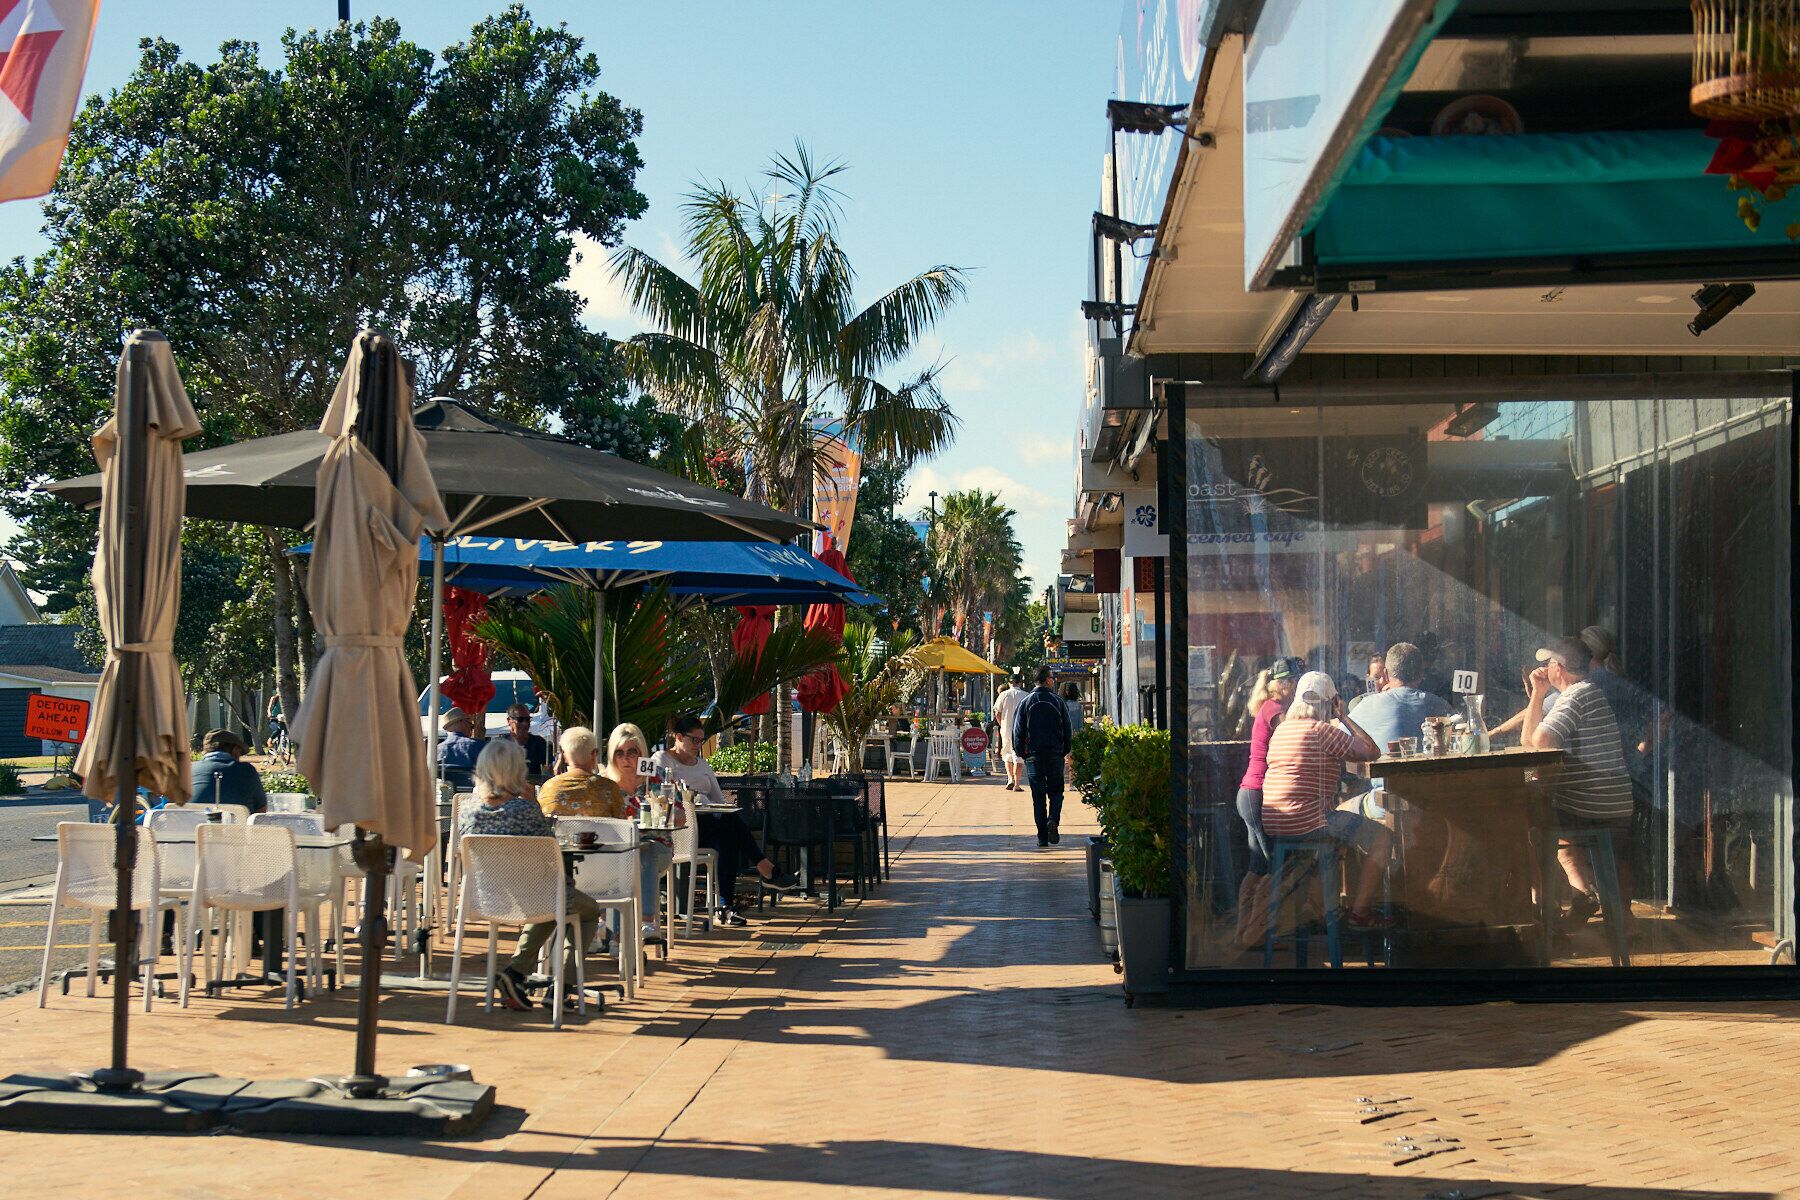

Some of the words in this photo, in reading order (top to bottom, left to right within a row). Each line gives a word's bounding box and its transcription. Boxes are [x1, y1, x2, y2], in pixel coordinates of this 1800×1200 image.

[1188, 479, 1237, 496] oast
[1187, 532, 1256, 544] censed
[1458, 674, 1473, 690] 10
[37, 700, 80, 713] DETOUR
[38, 712, 77, 724] AHEAD
[31, 726, 62, 736] FOLLOW
[640, 760, 654, 774] 84
